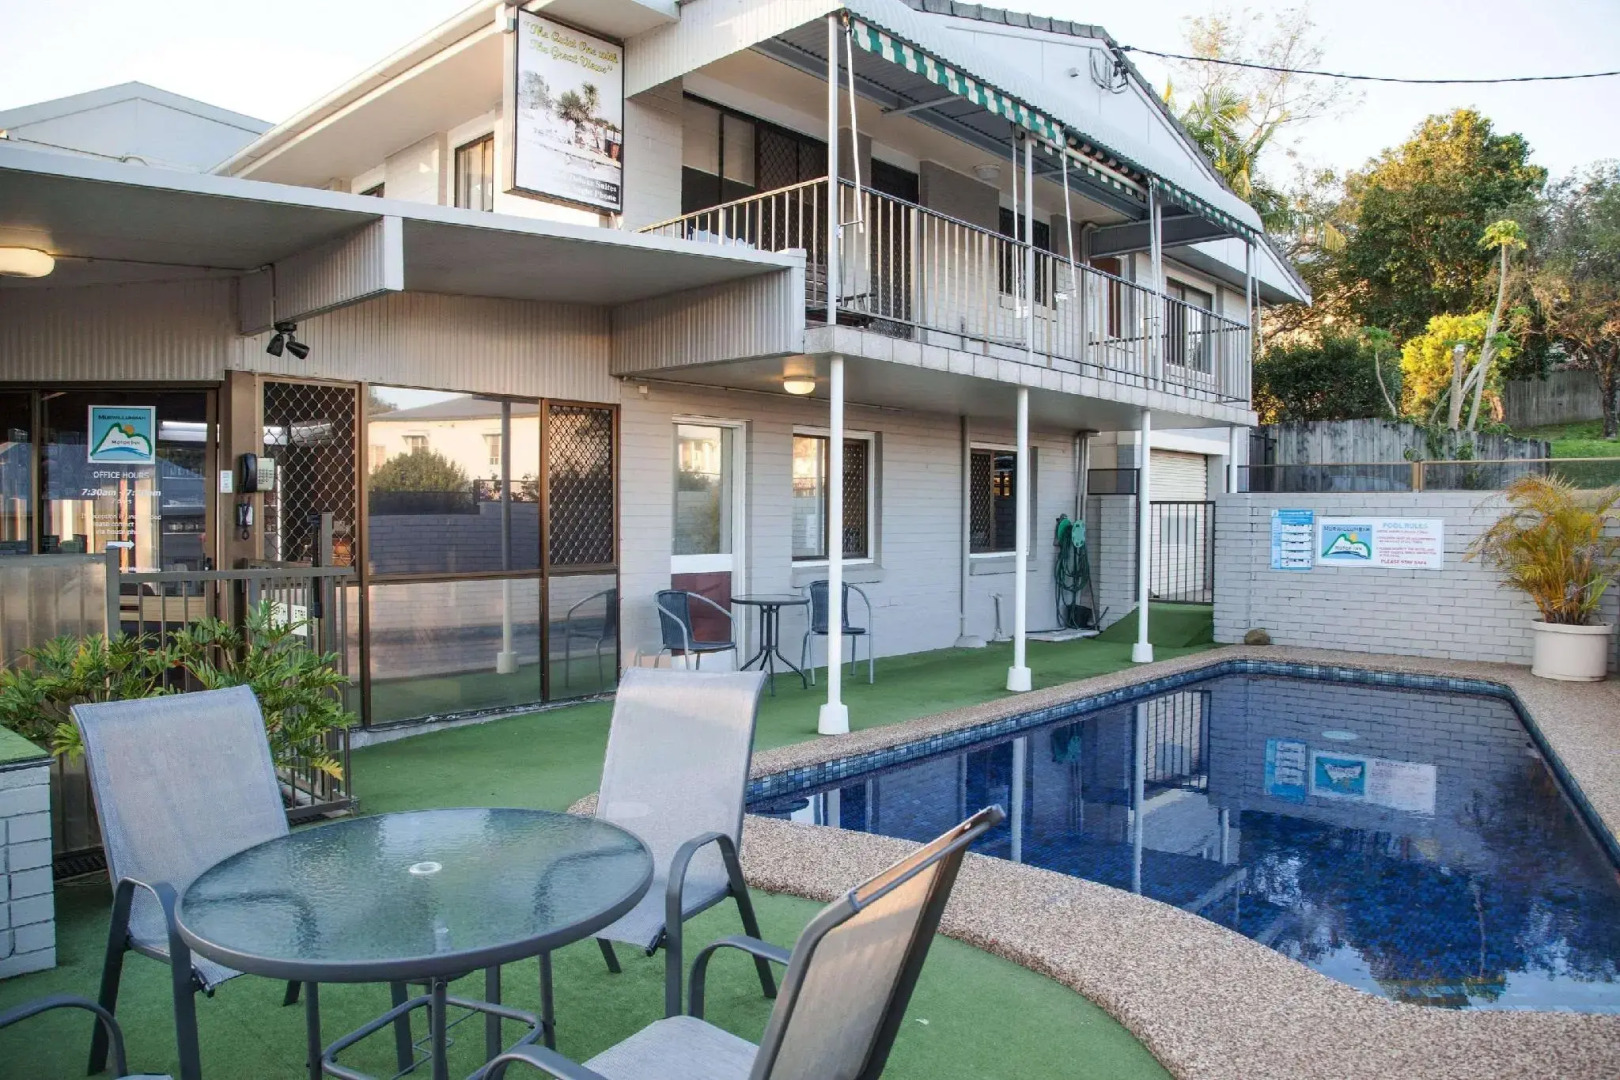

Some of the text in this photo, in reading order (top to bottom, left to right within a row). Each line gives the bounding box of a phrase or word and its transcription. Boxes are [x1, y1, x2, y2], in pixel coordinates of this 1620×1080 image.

[595, 180, 617, 192] Suites
[93, 471, 150, 479] OFFICE HOURS
[81, 488, 116, 496] 7:30am
